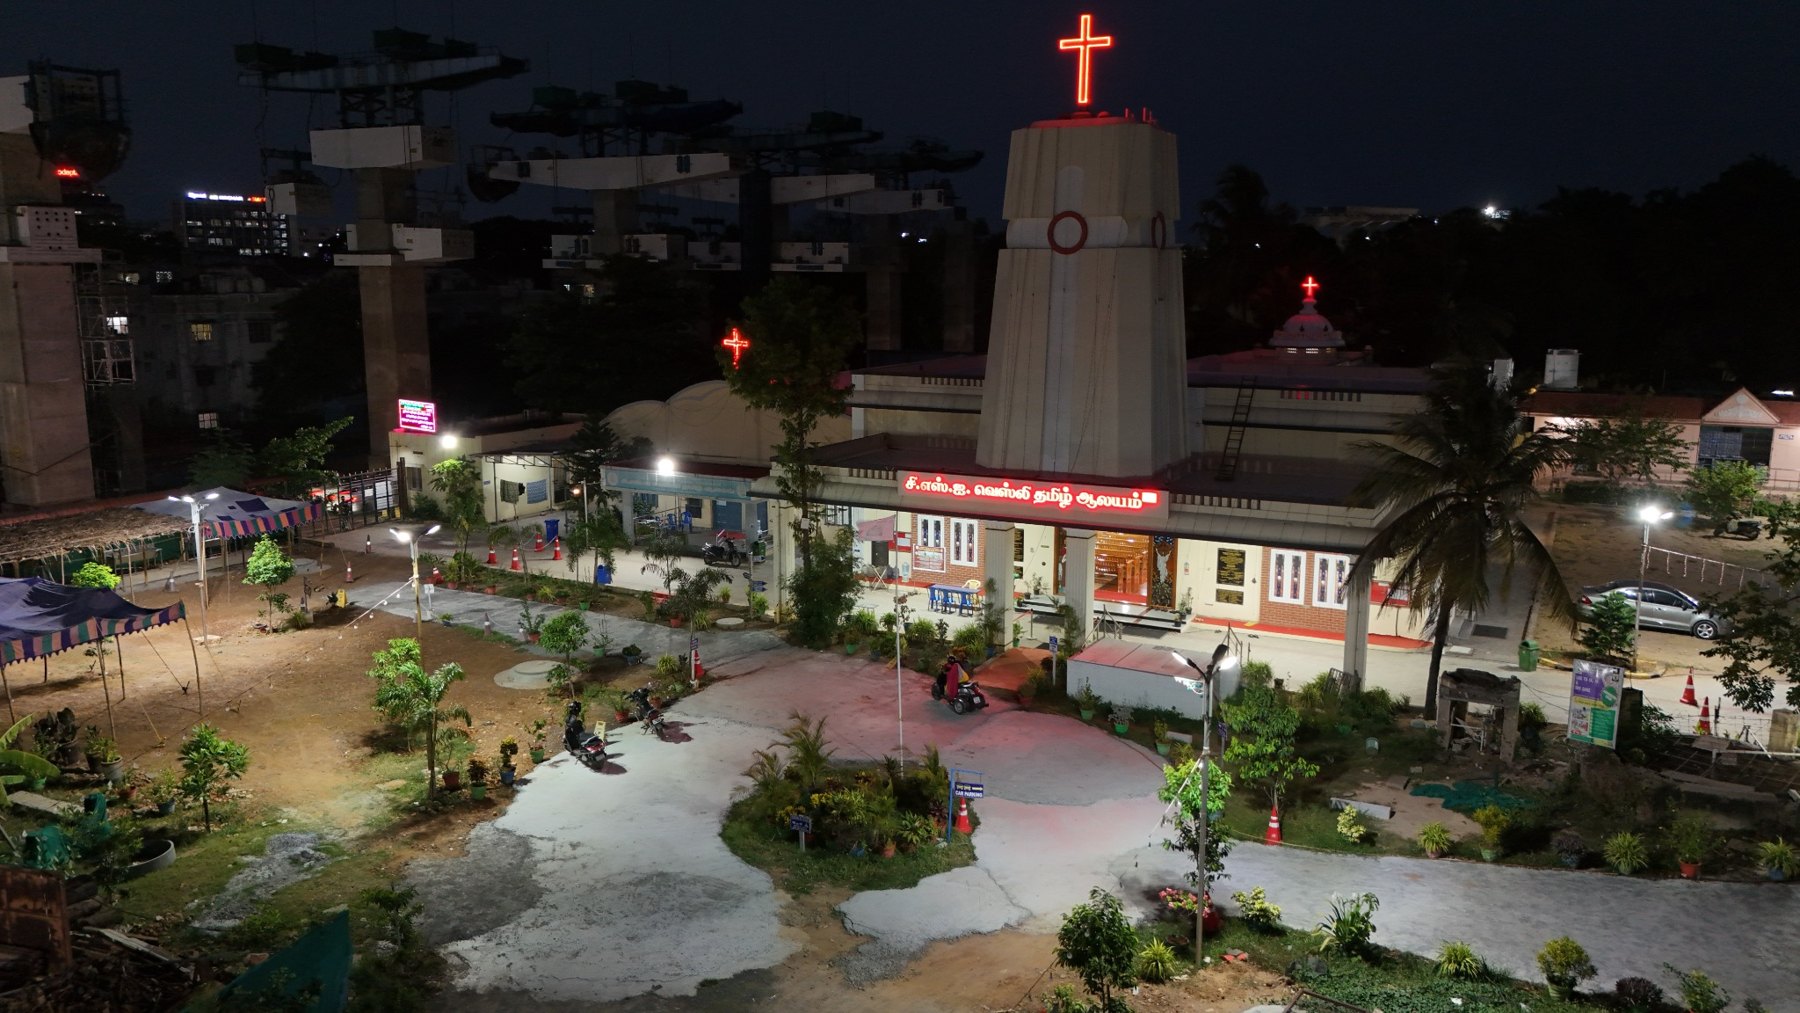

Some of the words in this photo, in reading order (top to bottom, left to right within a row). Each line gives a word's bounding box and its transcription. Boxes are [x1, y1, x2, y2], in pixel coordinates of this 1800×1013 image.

[974, 481, 1031, 500] வெஸ்லி
[1033, 486, 1073, 509] தமிழ்
[1076, 491, 1143, 509] ஆலயம்
